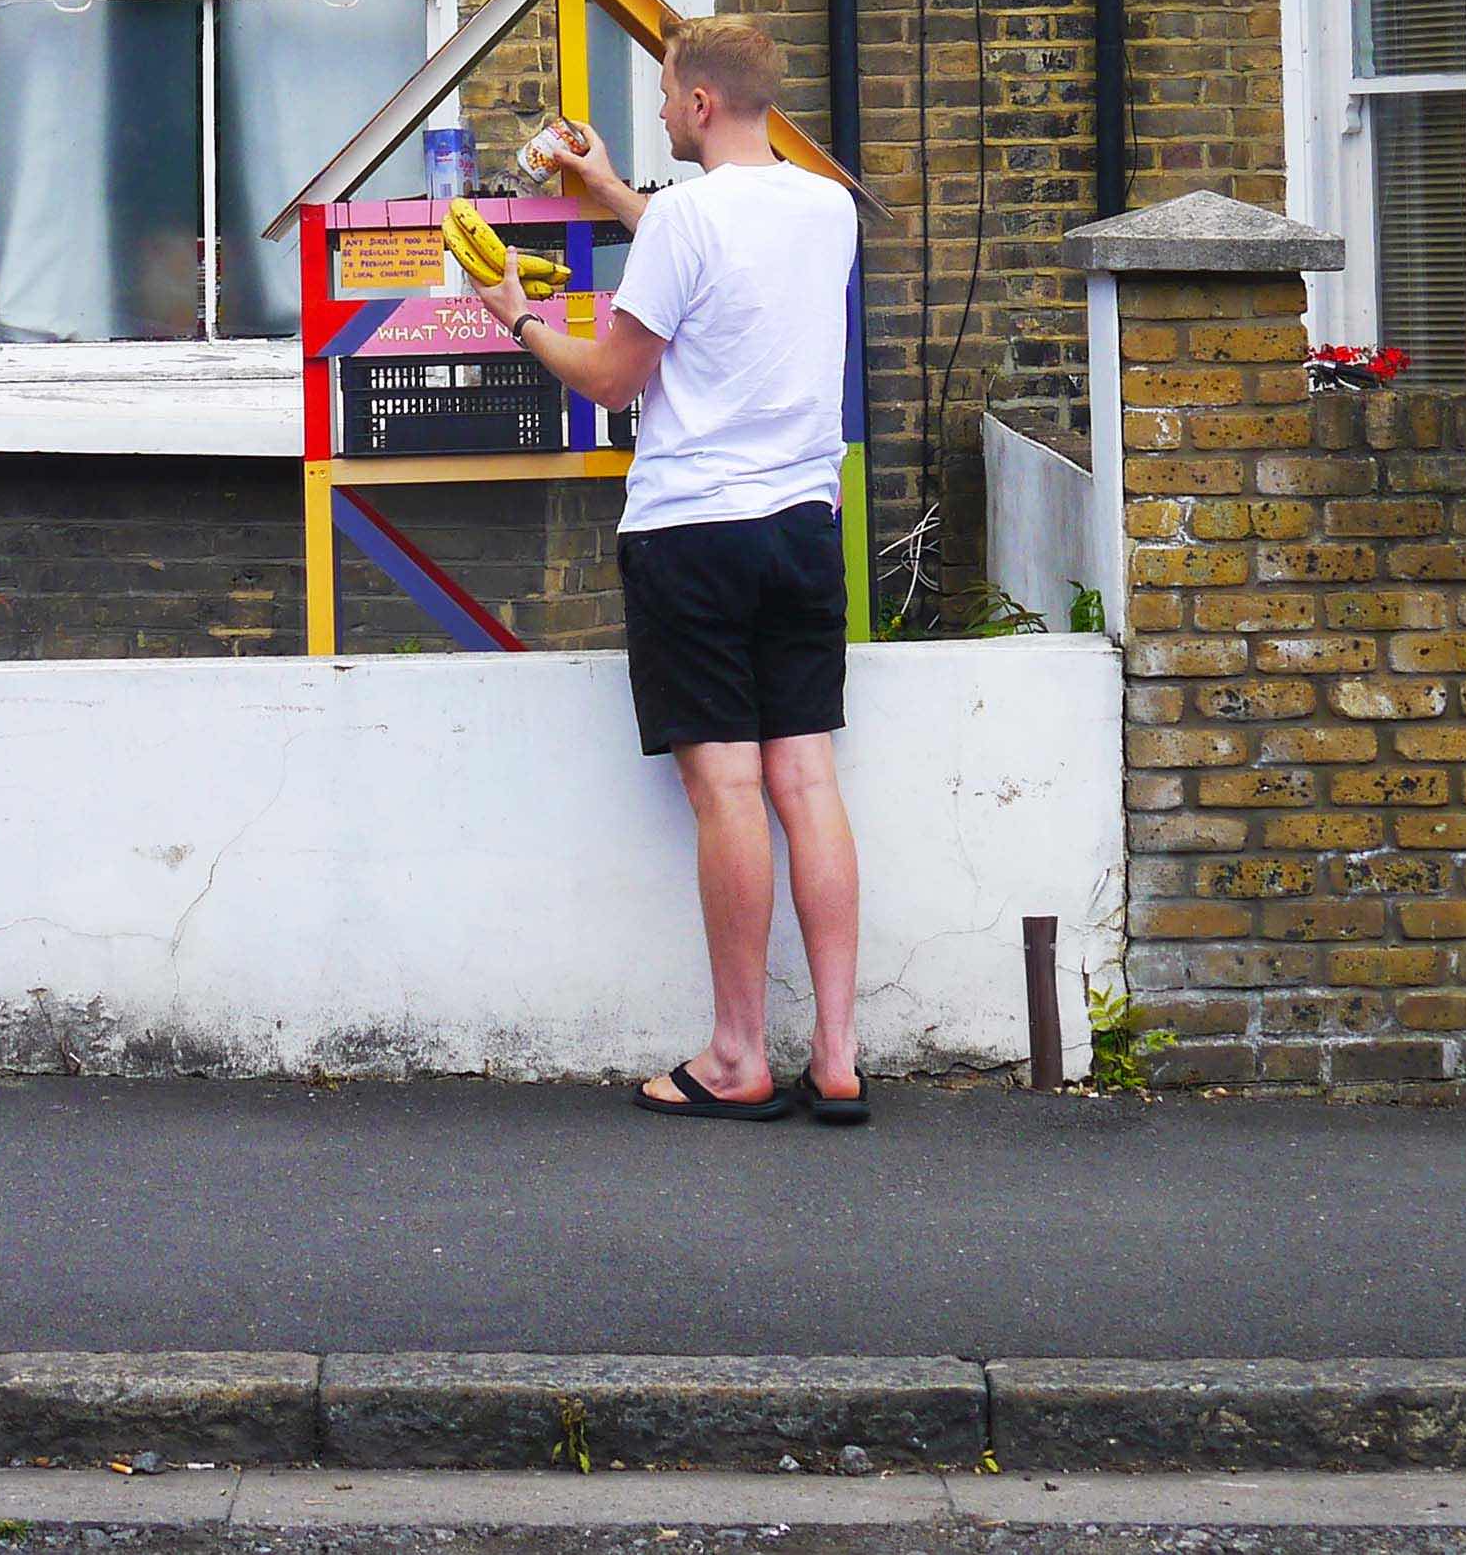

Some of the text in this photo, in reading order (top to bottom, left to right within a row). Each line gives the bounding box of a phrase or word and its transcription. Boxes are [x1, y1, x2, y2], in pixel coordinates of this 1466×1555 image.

[345, 239, 363, 247] ANY
[435, 308, 493, 324] TAKE
[378, 325, 438, 341] WHAT
[445, 325, 486, 340] YOU
